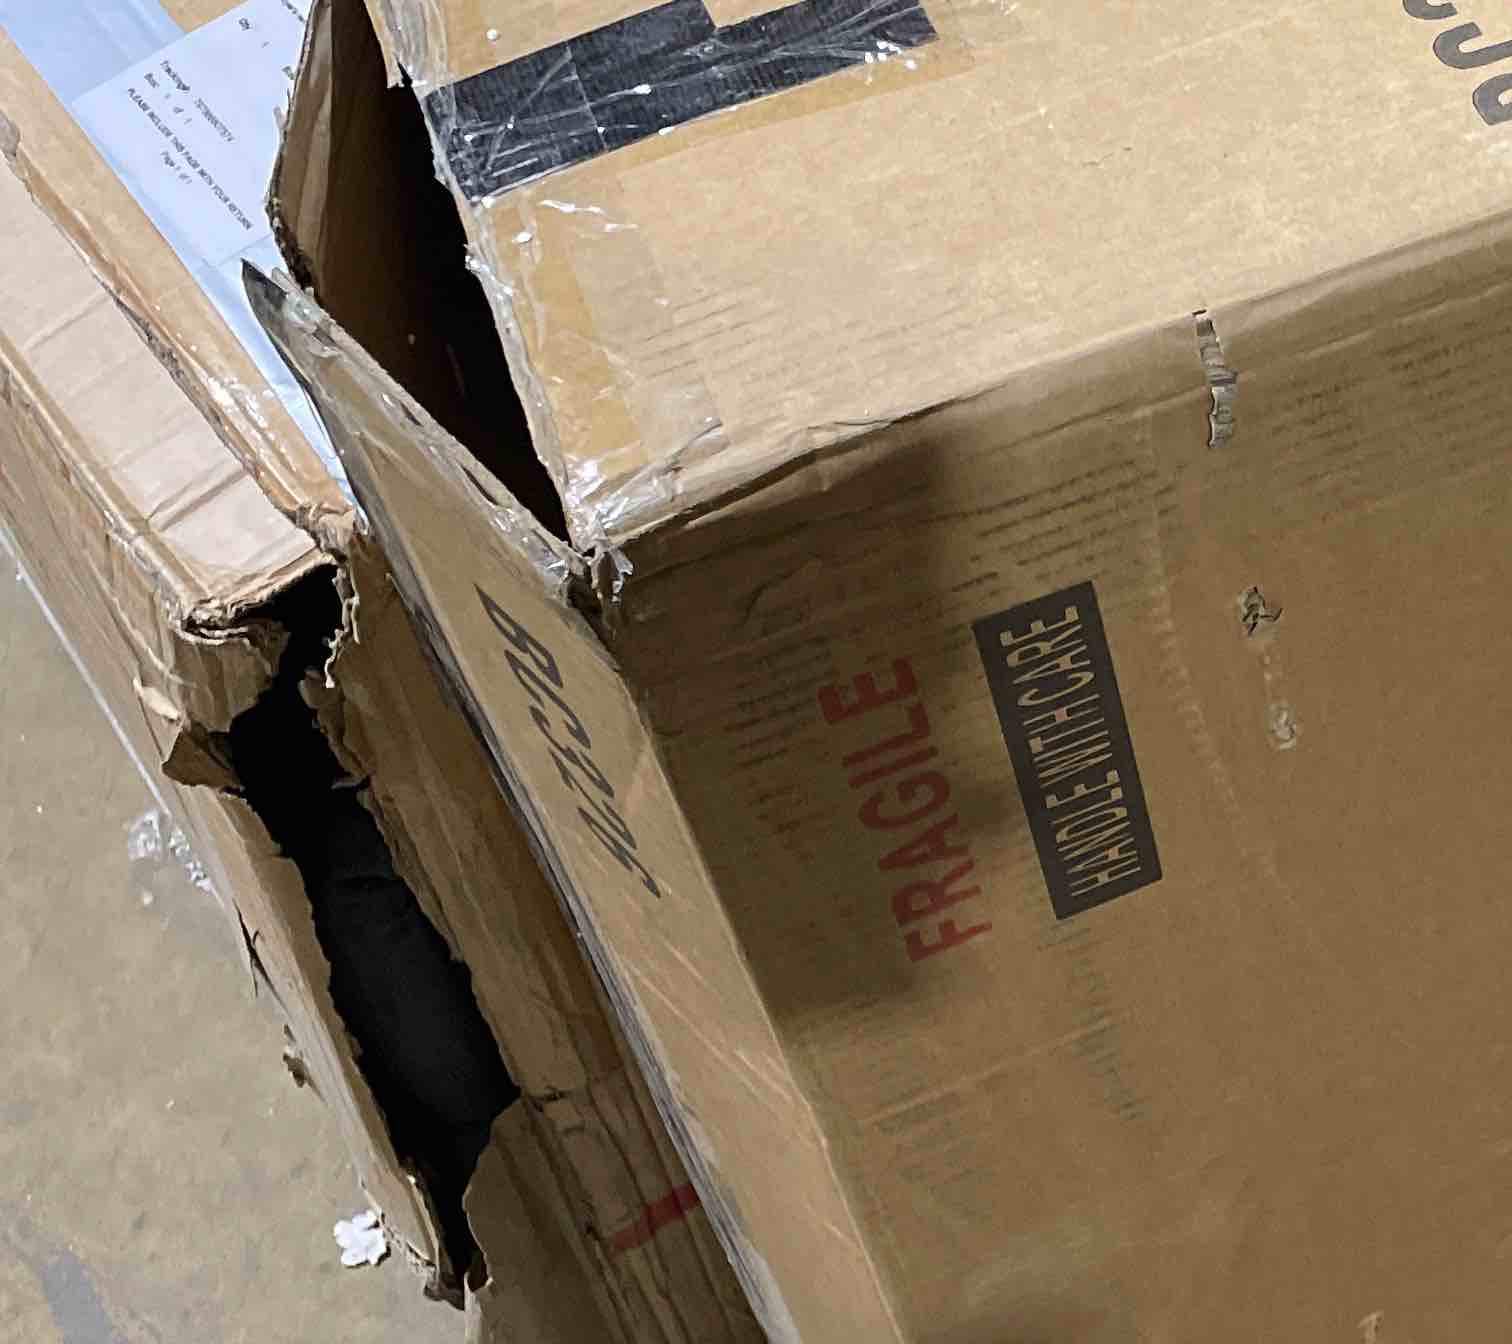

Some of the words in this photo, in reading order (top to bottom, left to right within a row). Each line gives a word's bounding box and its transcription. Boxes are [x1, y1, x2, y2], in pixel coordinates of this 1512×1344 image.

[999, 605, 1097, 707] CARE
[1022, 692, 1113, 789] WITH
[817, 657, 994, 964] FRAGILE
[1045, 769, 1142, 897] HANDLE
